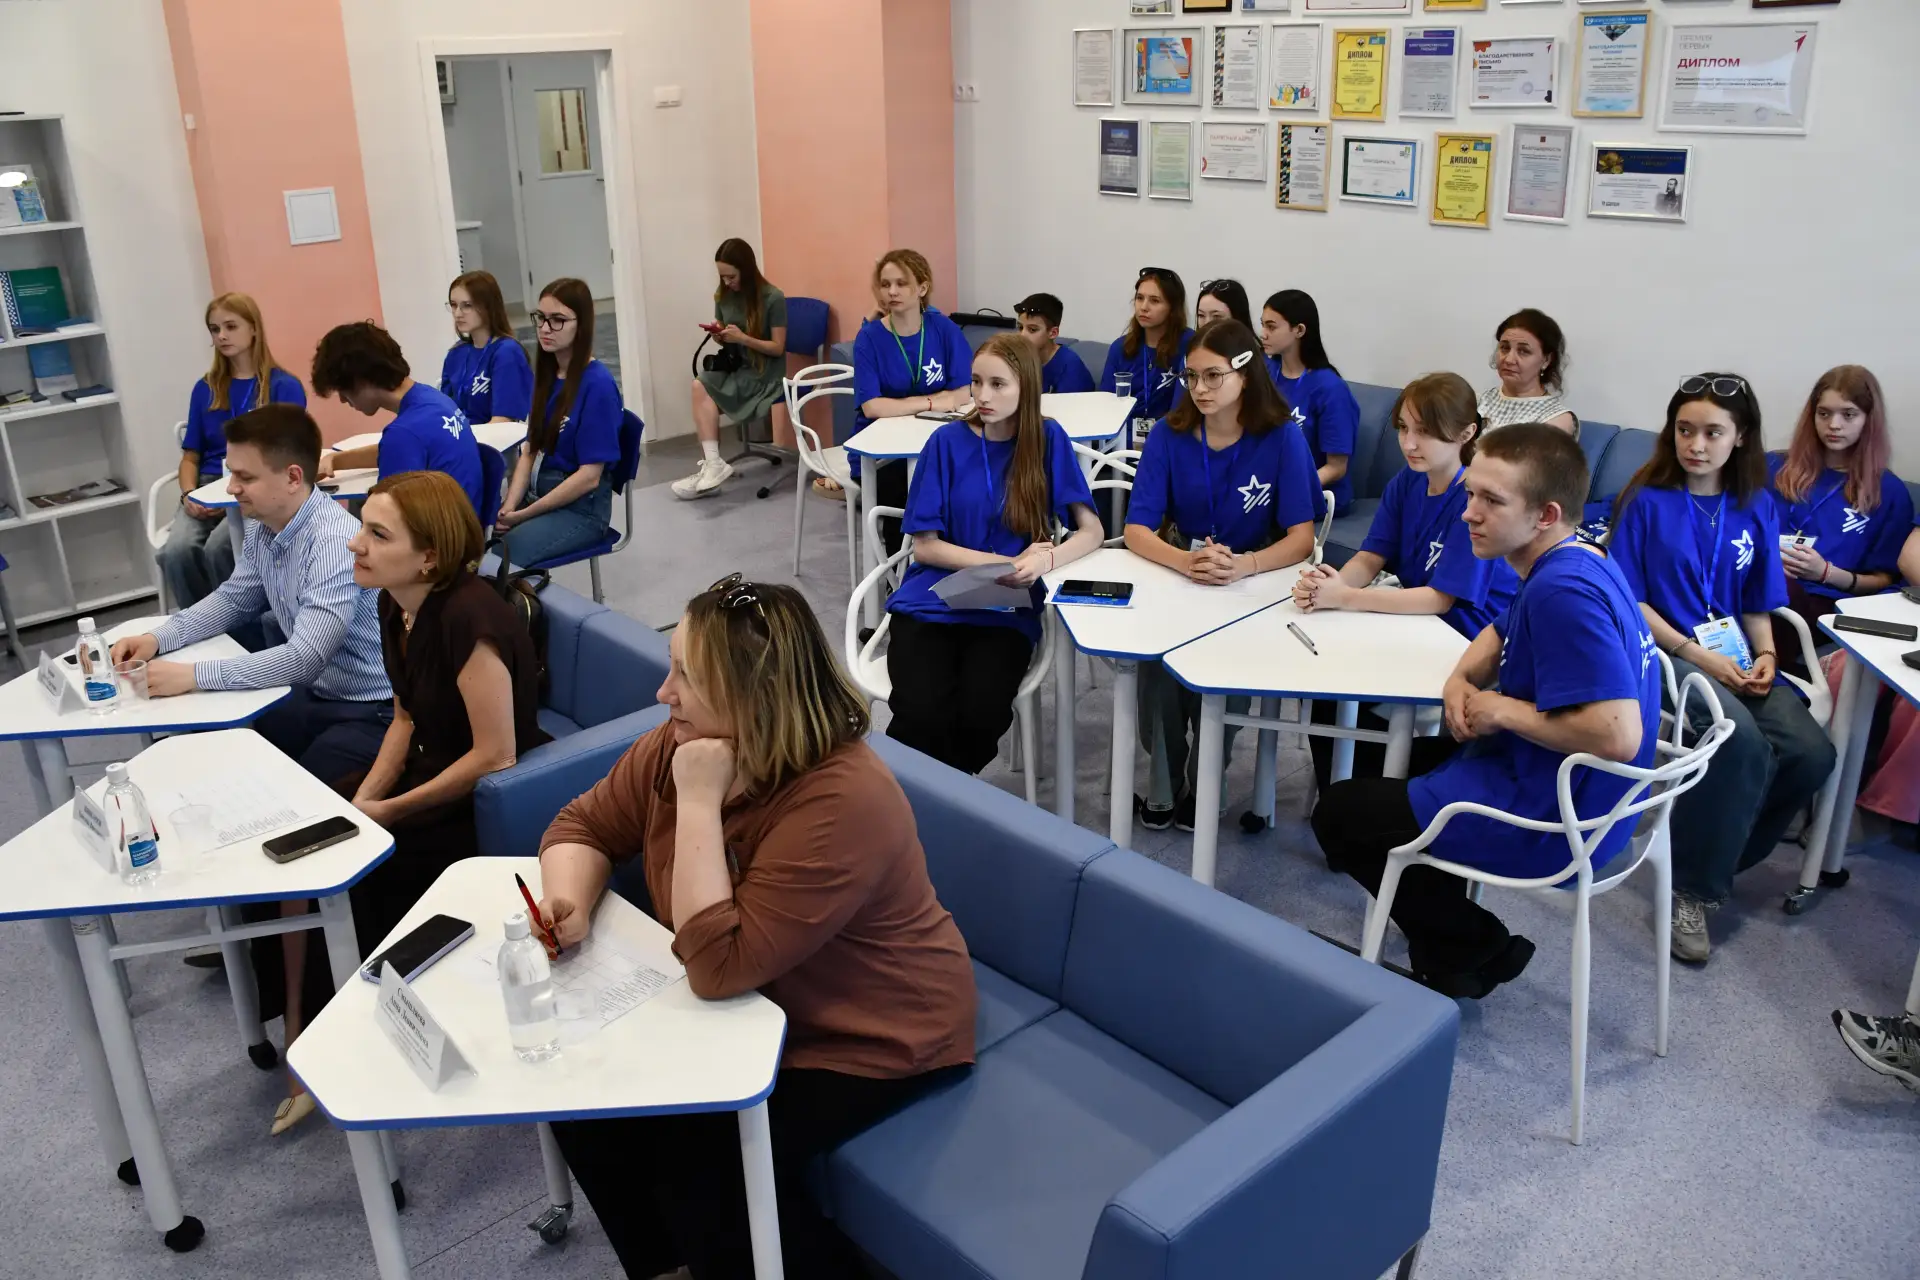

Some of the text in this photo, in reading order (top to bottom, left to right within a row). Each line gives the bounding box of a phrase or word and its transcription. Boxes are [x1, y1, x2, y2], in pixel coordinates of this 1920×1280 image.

[1679, 42, 1709, 50] ПЕРВЫХ
[1347, 50, 1373, 59] ДИПЛОМ
[1677, 57, 1741, 69] ДИПЛОМ
[1449, 155, 1478, 165] ДИПЛОМ
